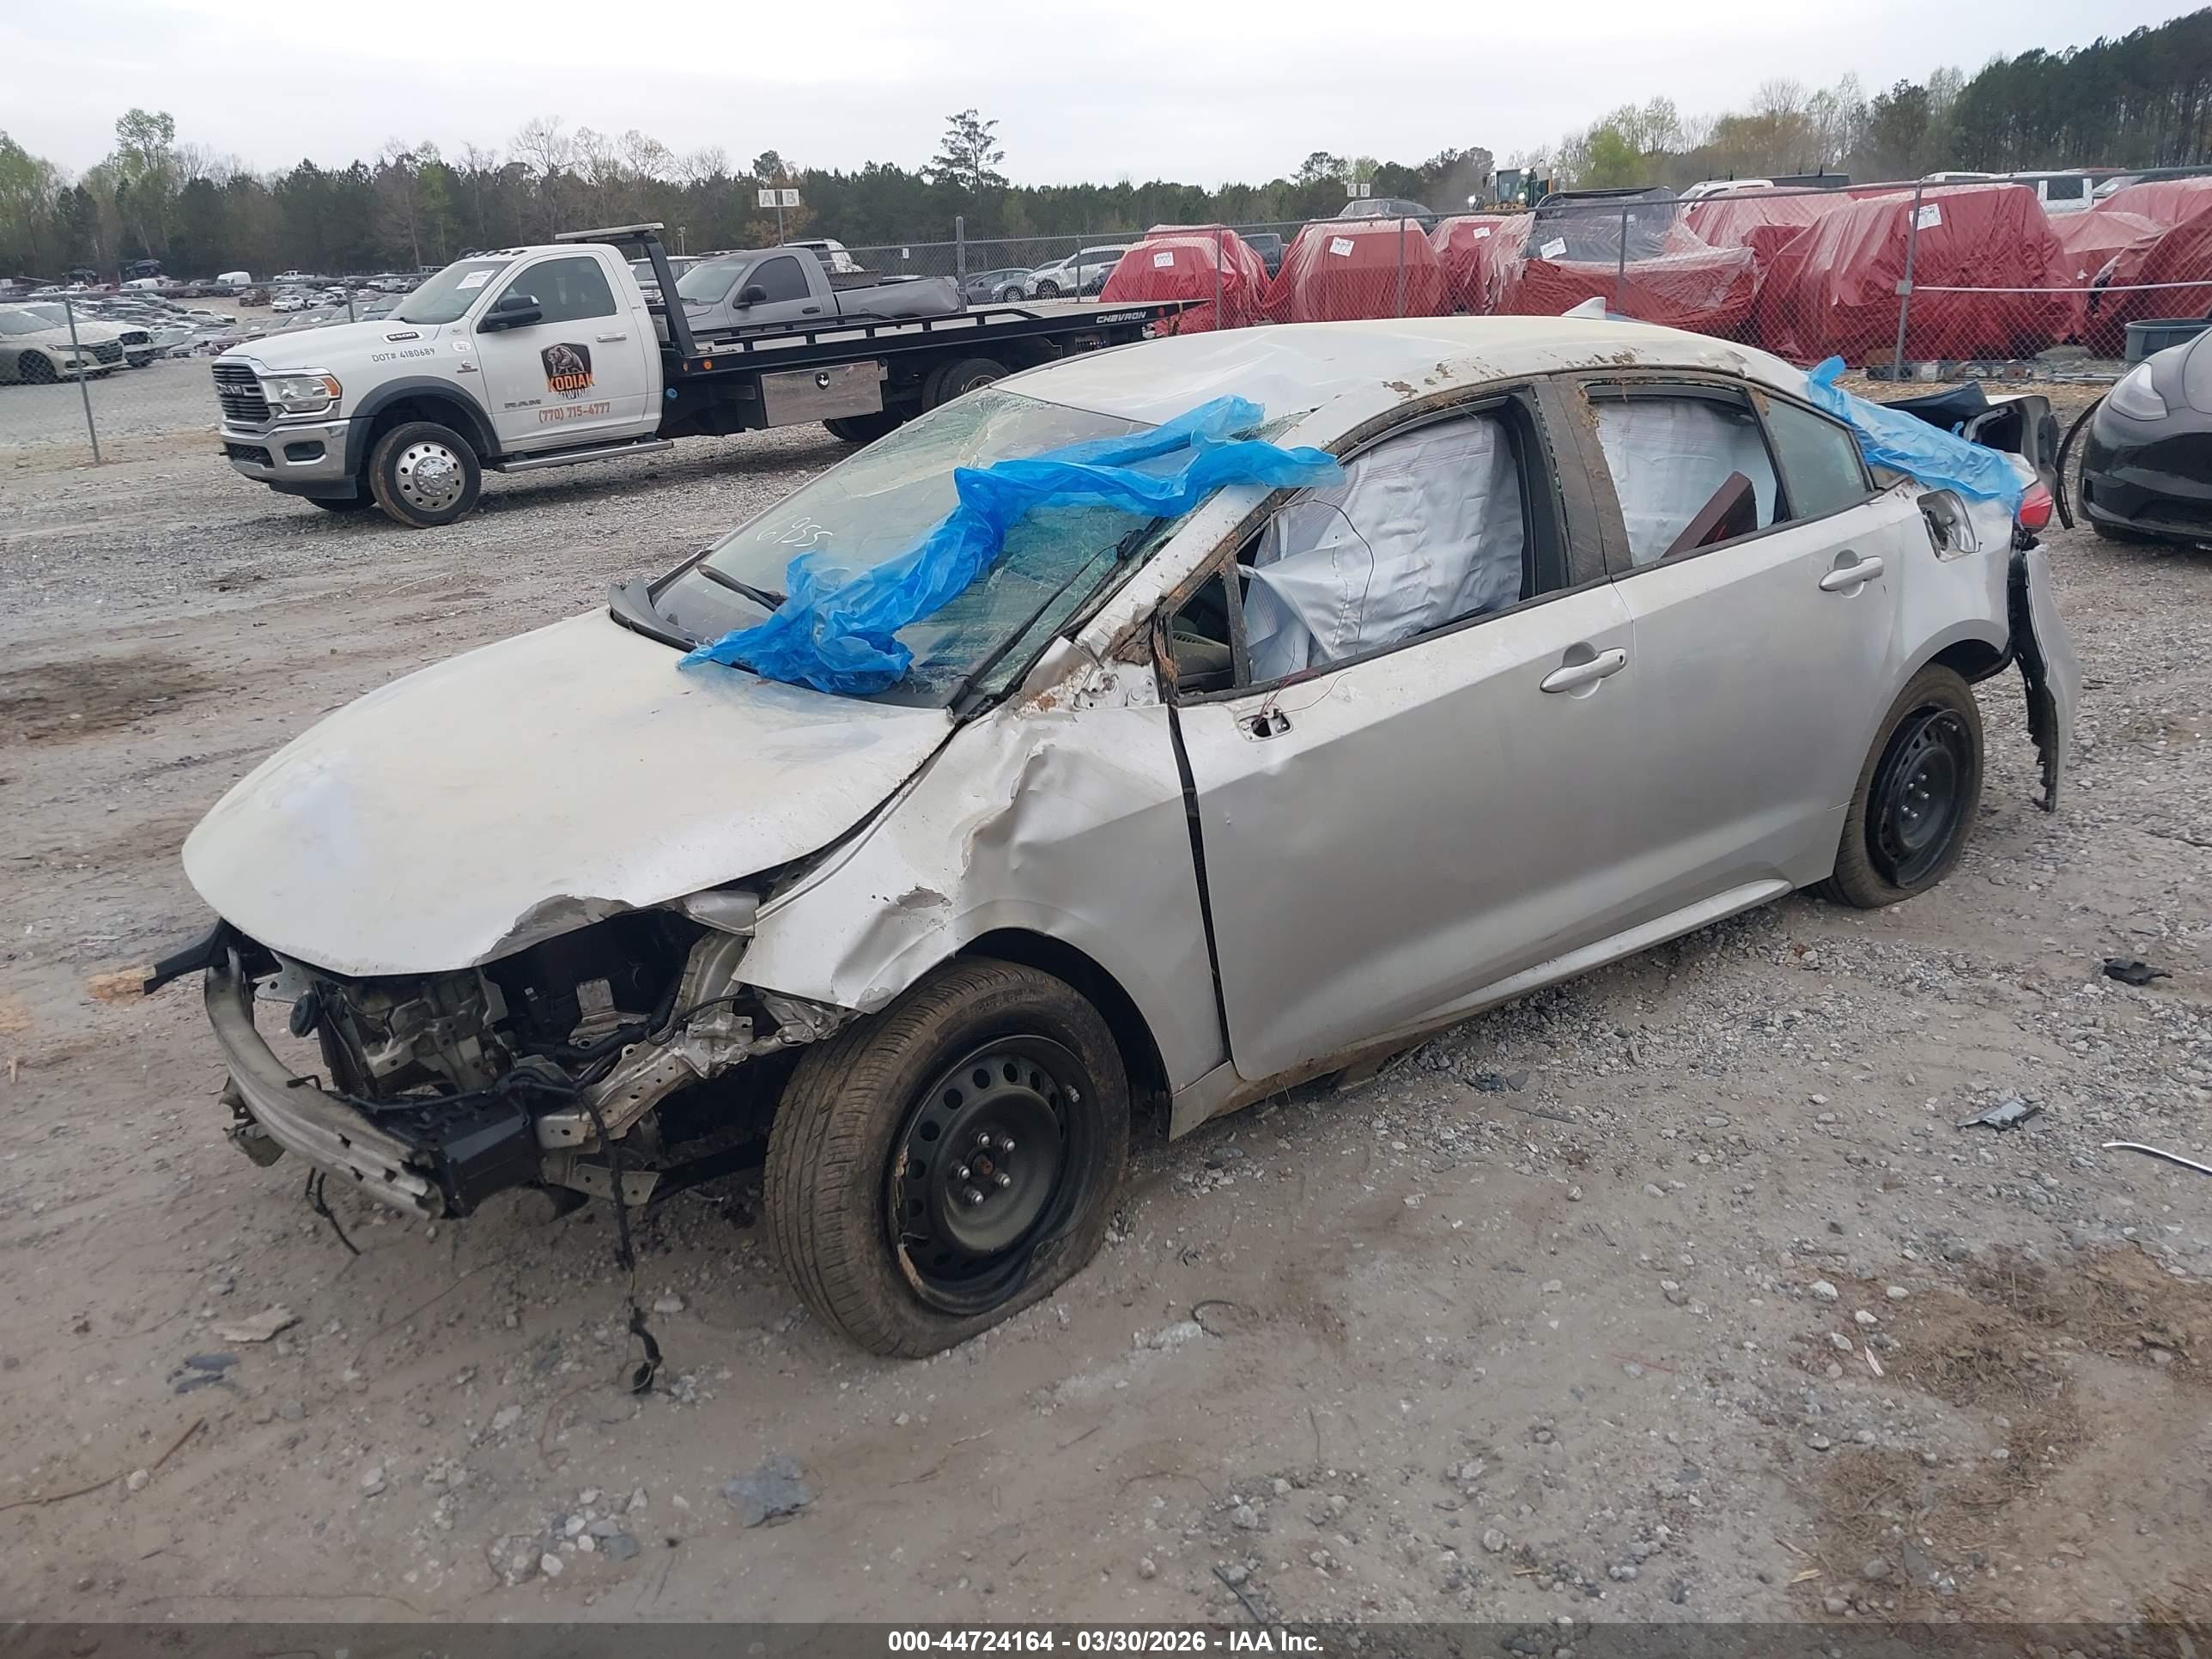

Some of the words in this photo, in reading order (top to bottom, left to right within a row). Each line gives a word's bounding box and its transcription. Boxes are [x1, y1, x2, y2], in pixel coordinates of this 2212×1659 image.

[762, 191, 774, 205] A
[787, 191, 797, 205] B
[1096, 311, 1146, 324] CHEVRON
[372, 352, 396, 362] DOT#
[399, 347, 435, 359] 4180689
[547, 372, 595, 392] KODIAK
[504, 399, 541, 408] RAM
[538, 407, 564, 423] (770)
